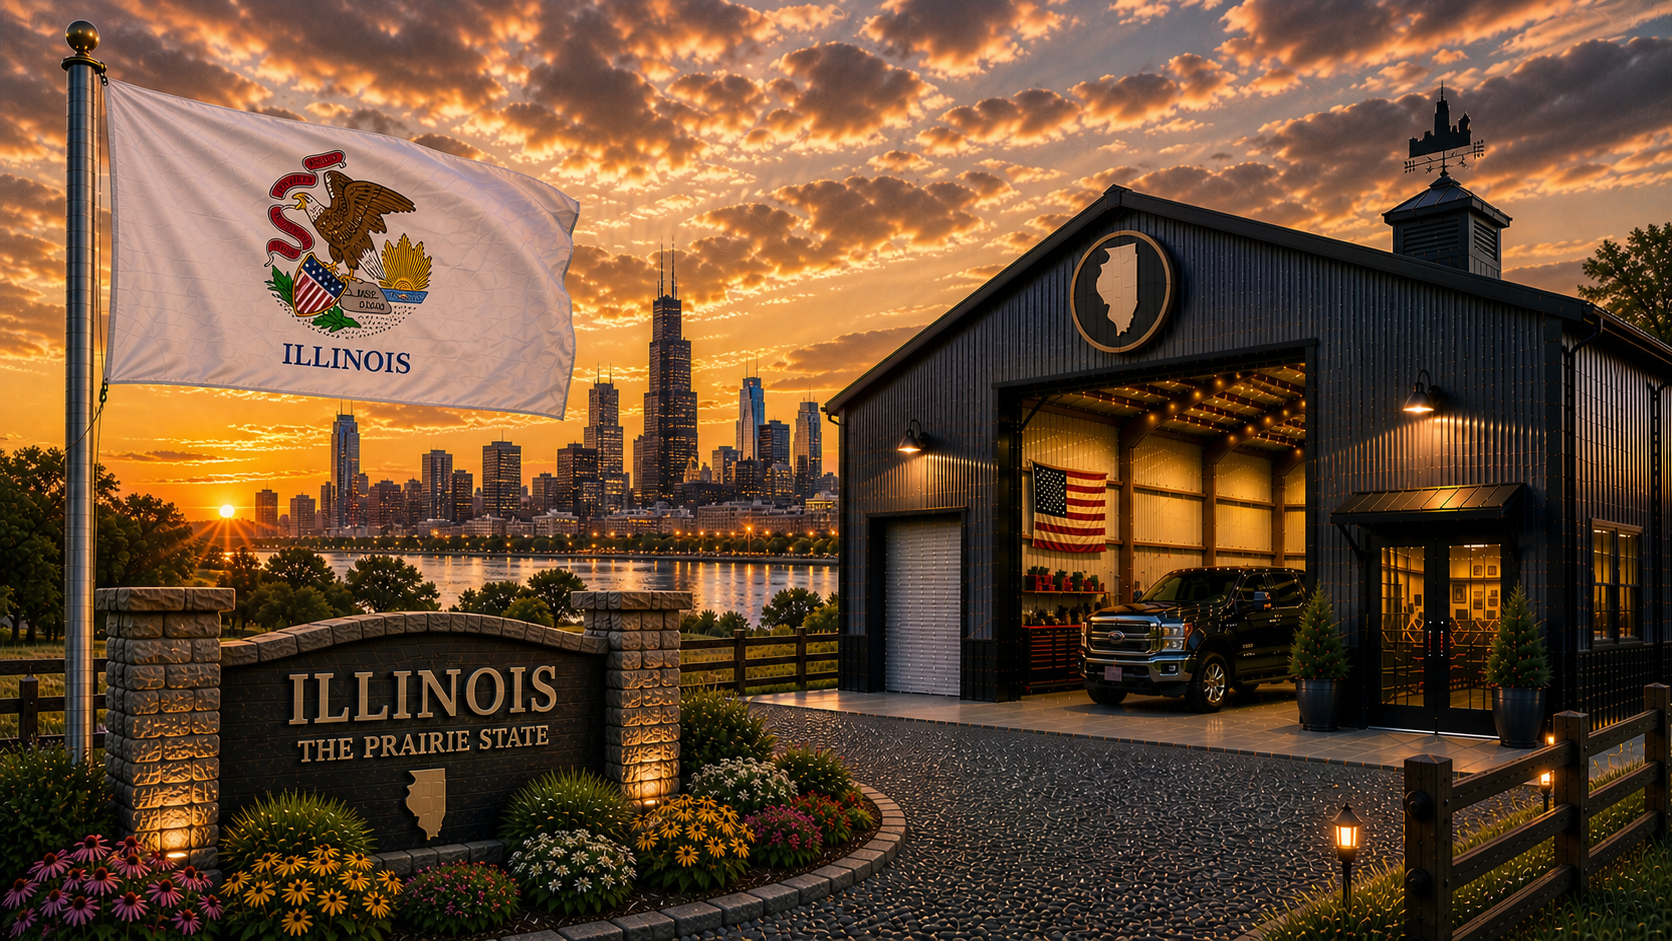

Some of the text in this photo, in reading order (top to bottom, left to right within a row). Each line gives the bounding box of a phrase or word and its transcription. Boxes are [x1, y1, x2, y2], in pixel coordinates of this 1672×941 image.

[282, 343, 411, 374] ILLINOIS
[288, 665, 558, 726] ILLINOIS
[297, 724, 550, 763] THE PRAIRIE STATE
